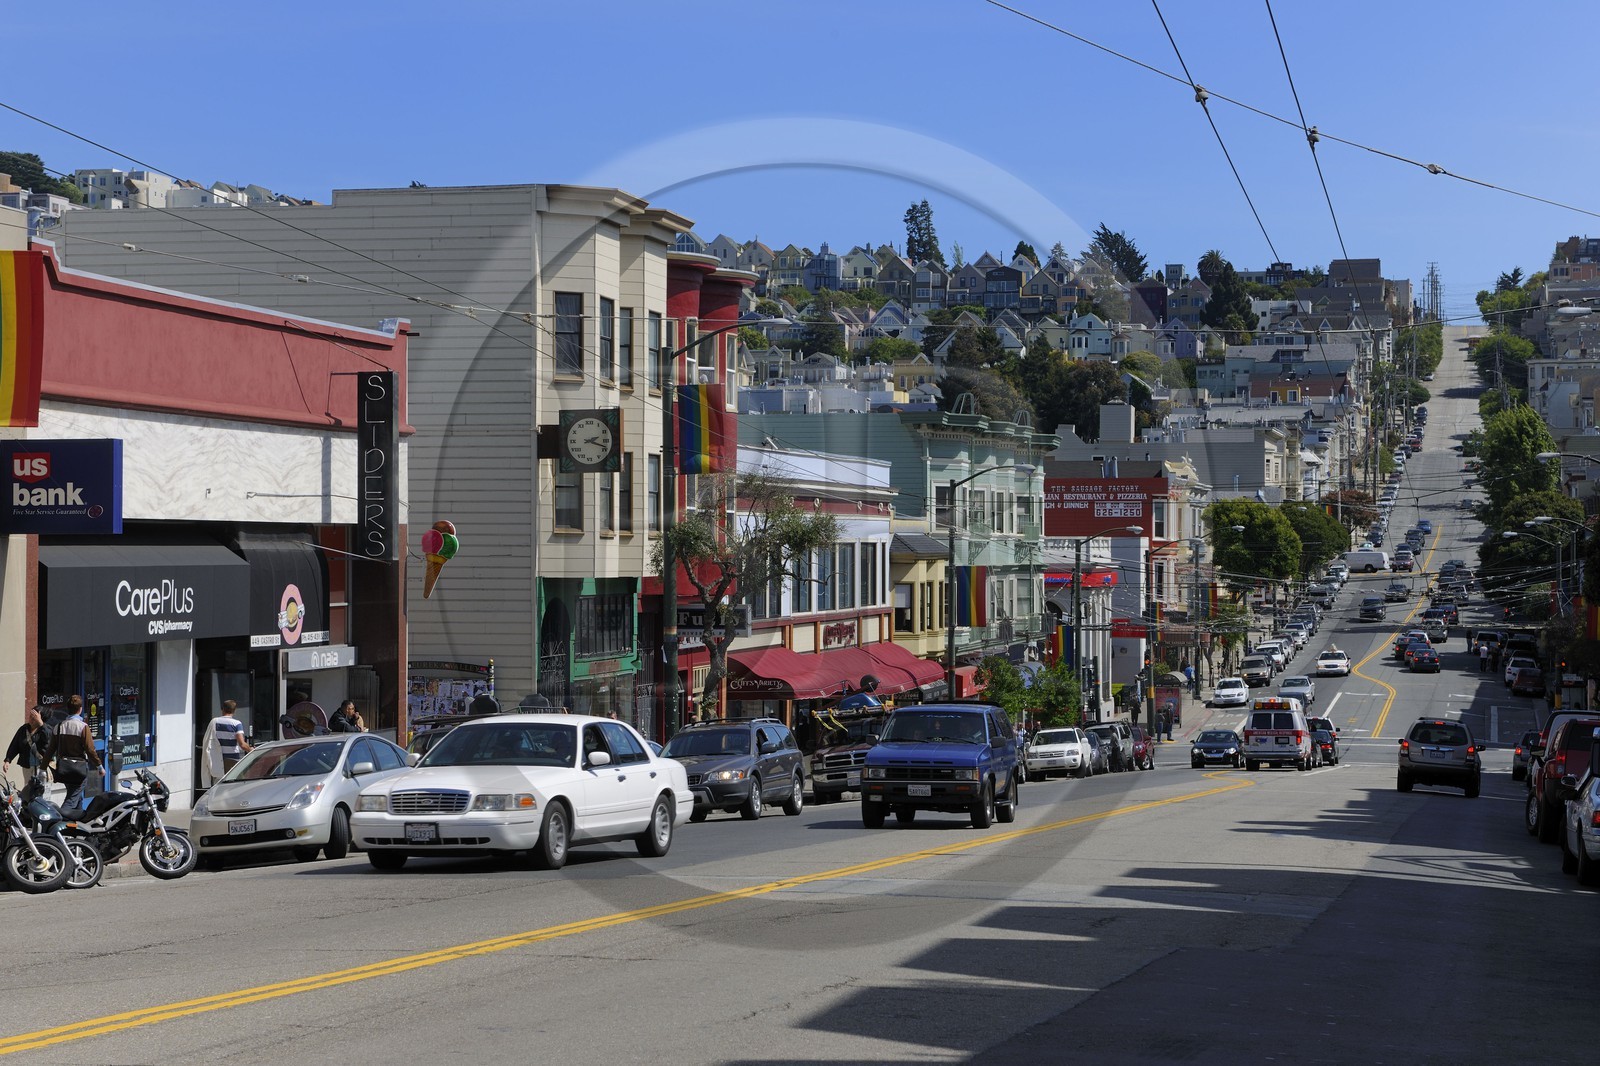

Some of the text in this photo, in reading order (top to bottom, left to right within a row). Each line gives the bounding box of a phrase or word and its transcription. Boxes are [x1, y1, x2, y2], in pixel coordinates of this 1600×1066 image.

[13, 457, 48, 477] us
[364, 374, 386, 557] SLIDERS
[12, 482, 85, 507] bank
[115, 579, 194, 617] CarePlus
[148, 620, 193, 635] CVS/pharmacy
[42, 694, 63, 704] CarePlus
